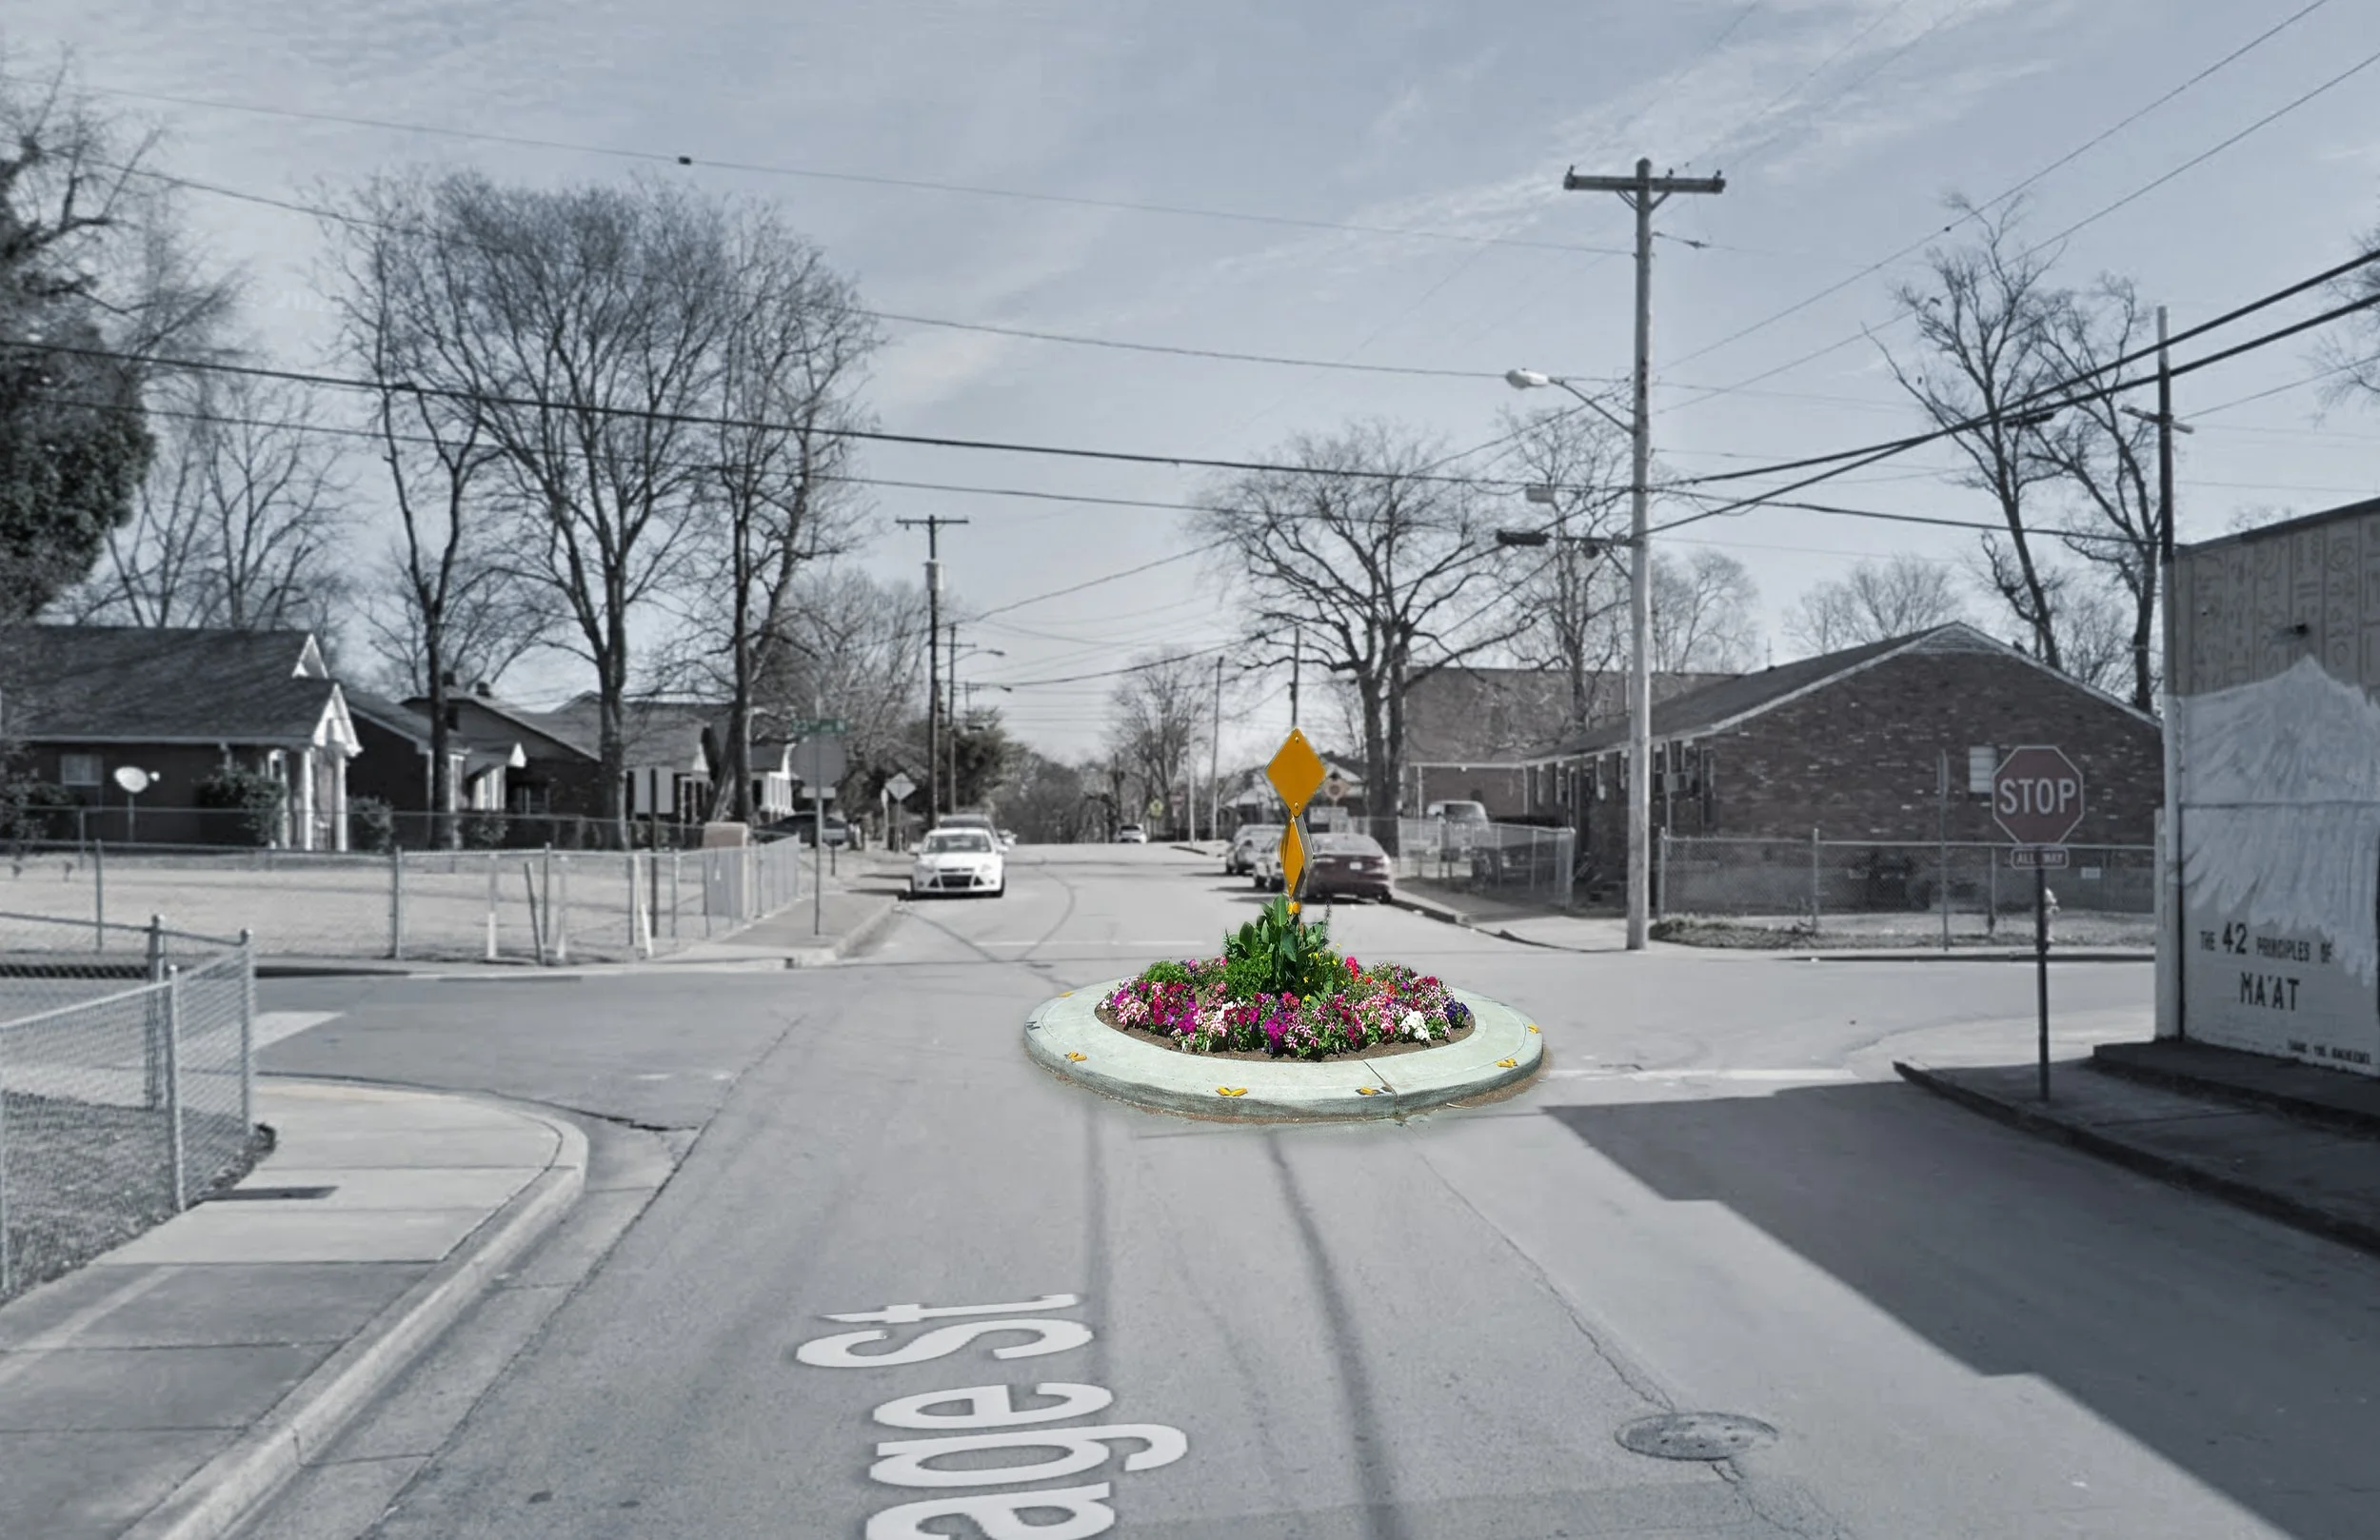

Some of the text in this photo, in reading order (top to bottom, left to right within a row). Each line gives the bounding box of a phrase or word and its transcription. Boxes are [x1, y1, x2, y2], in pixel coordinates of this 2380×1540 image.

[1999, 778, 2076, 815] STOP
[2016, 852, 2064, 864] ALL WAY
[2200, 921, 2332, 963] THE 42 PRINCIPLES OF
[2240, 971, 2300, 1011] MA'AT
[796, 1293, 1094, 1368] St
